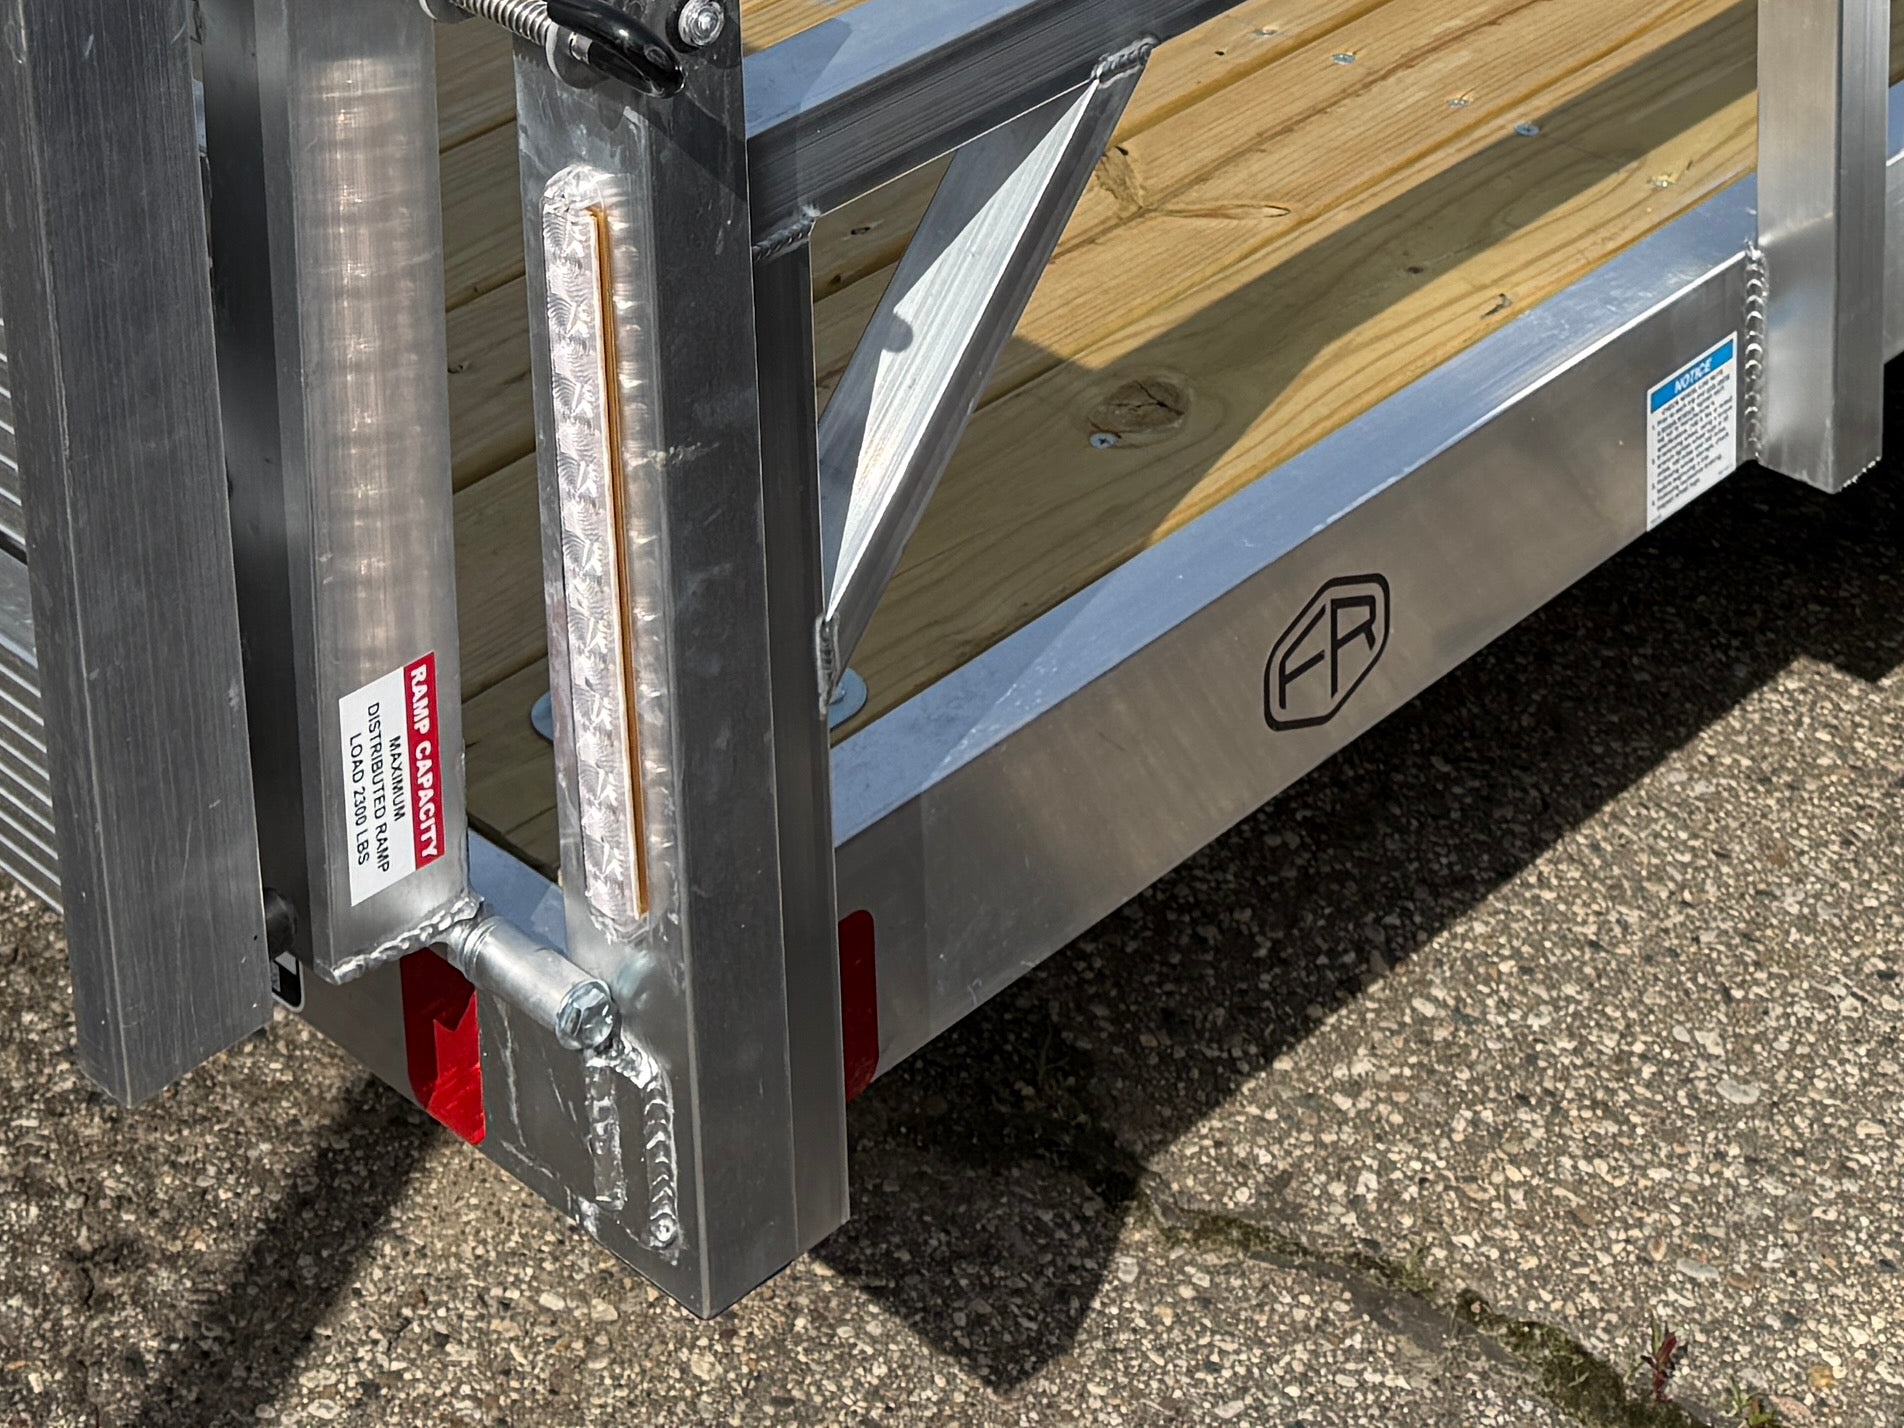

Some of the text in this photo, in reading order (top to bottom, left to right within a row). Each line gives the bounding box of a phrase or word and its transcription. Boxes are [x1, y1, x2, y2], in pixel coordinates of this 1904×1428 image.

[1674, 356, 1713, 394] NOTICE
[349, 732, 370, 866] LOAD 2300 LBS
[367, 702, 390, 873] DISTRIBUTED RAMP
[388, 734, 406, 822] MAXIMUM
[411, 663, 438, 859] RAMP CAPACITY
